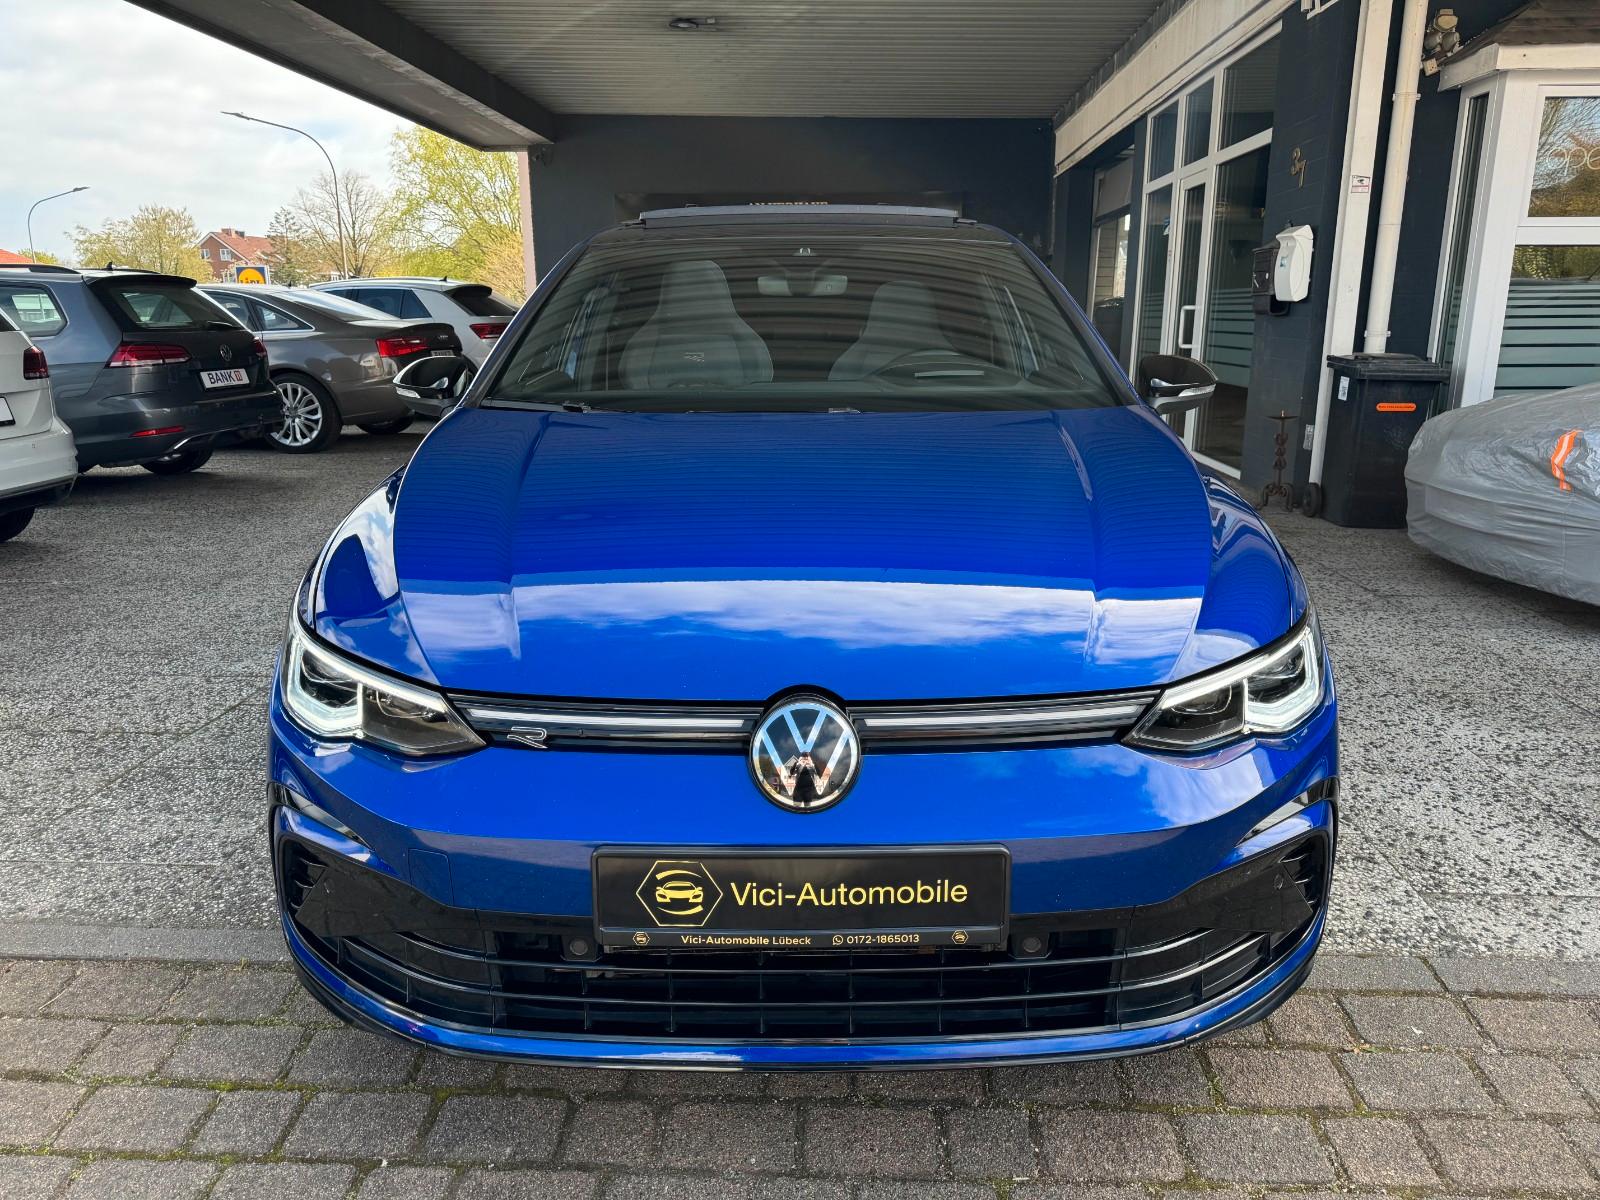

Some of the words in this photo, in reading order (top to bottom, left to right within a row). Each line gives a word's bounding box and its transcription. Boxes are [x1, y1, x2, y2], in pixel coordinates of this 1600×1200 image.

[1290, 147, 1307, 188] 37
[730, 879, 968, 907] Vici-Automobile
[680, 935, 770, 945] Vici-Automobile
[772, 936, 812, 945] Lübeck
[846, 934, 920, 944] 0172-1865013
